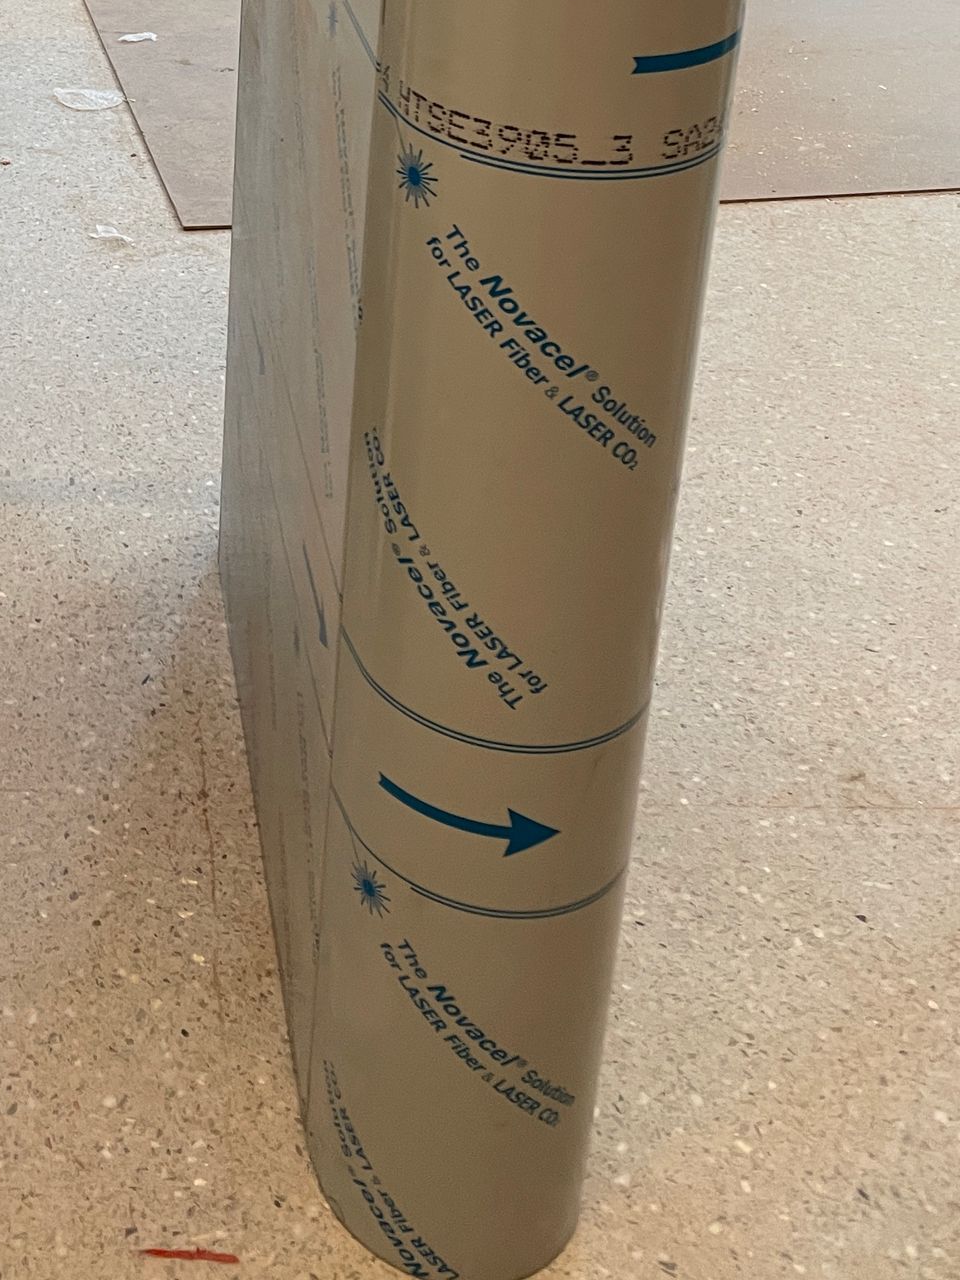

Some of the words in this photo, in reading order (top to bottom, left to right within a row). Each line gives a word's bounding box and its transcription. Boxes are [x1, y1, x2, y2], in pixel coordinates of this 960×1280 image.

[425, 236, 452, 268] for
[446, 270, 504, 338] LASER
[499, 337, 550, 385] Fiber
[544, 386, 560, 400] &
[557, 395, 616, 448] LASER
[445, 224, 480, 272] The
[591, 385, 657, 449] Solution
[382, 471, 421, 542] LASER
[426, 560, 469, 612] Fiber
[465, 611, 523, 672] LASER
[487, 671, 524, 711] The
[518, 669, 549, 694] for
[397, 938, 428, 980] The
[380, 942, 402, 971] for
[398, 975, 448, 1034] LASER
[444, 1034, 487, 1072] Fiber
[492, 1078, 540, 1116] LASER
[340, 1107, 373, 1170] LASER
[377, 1189, 414, 1233] Fiber
